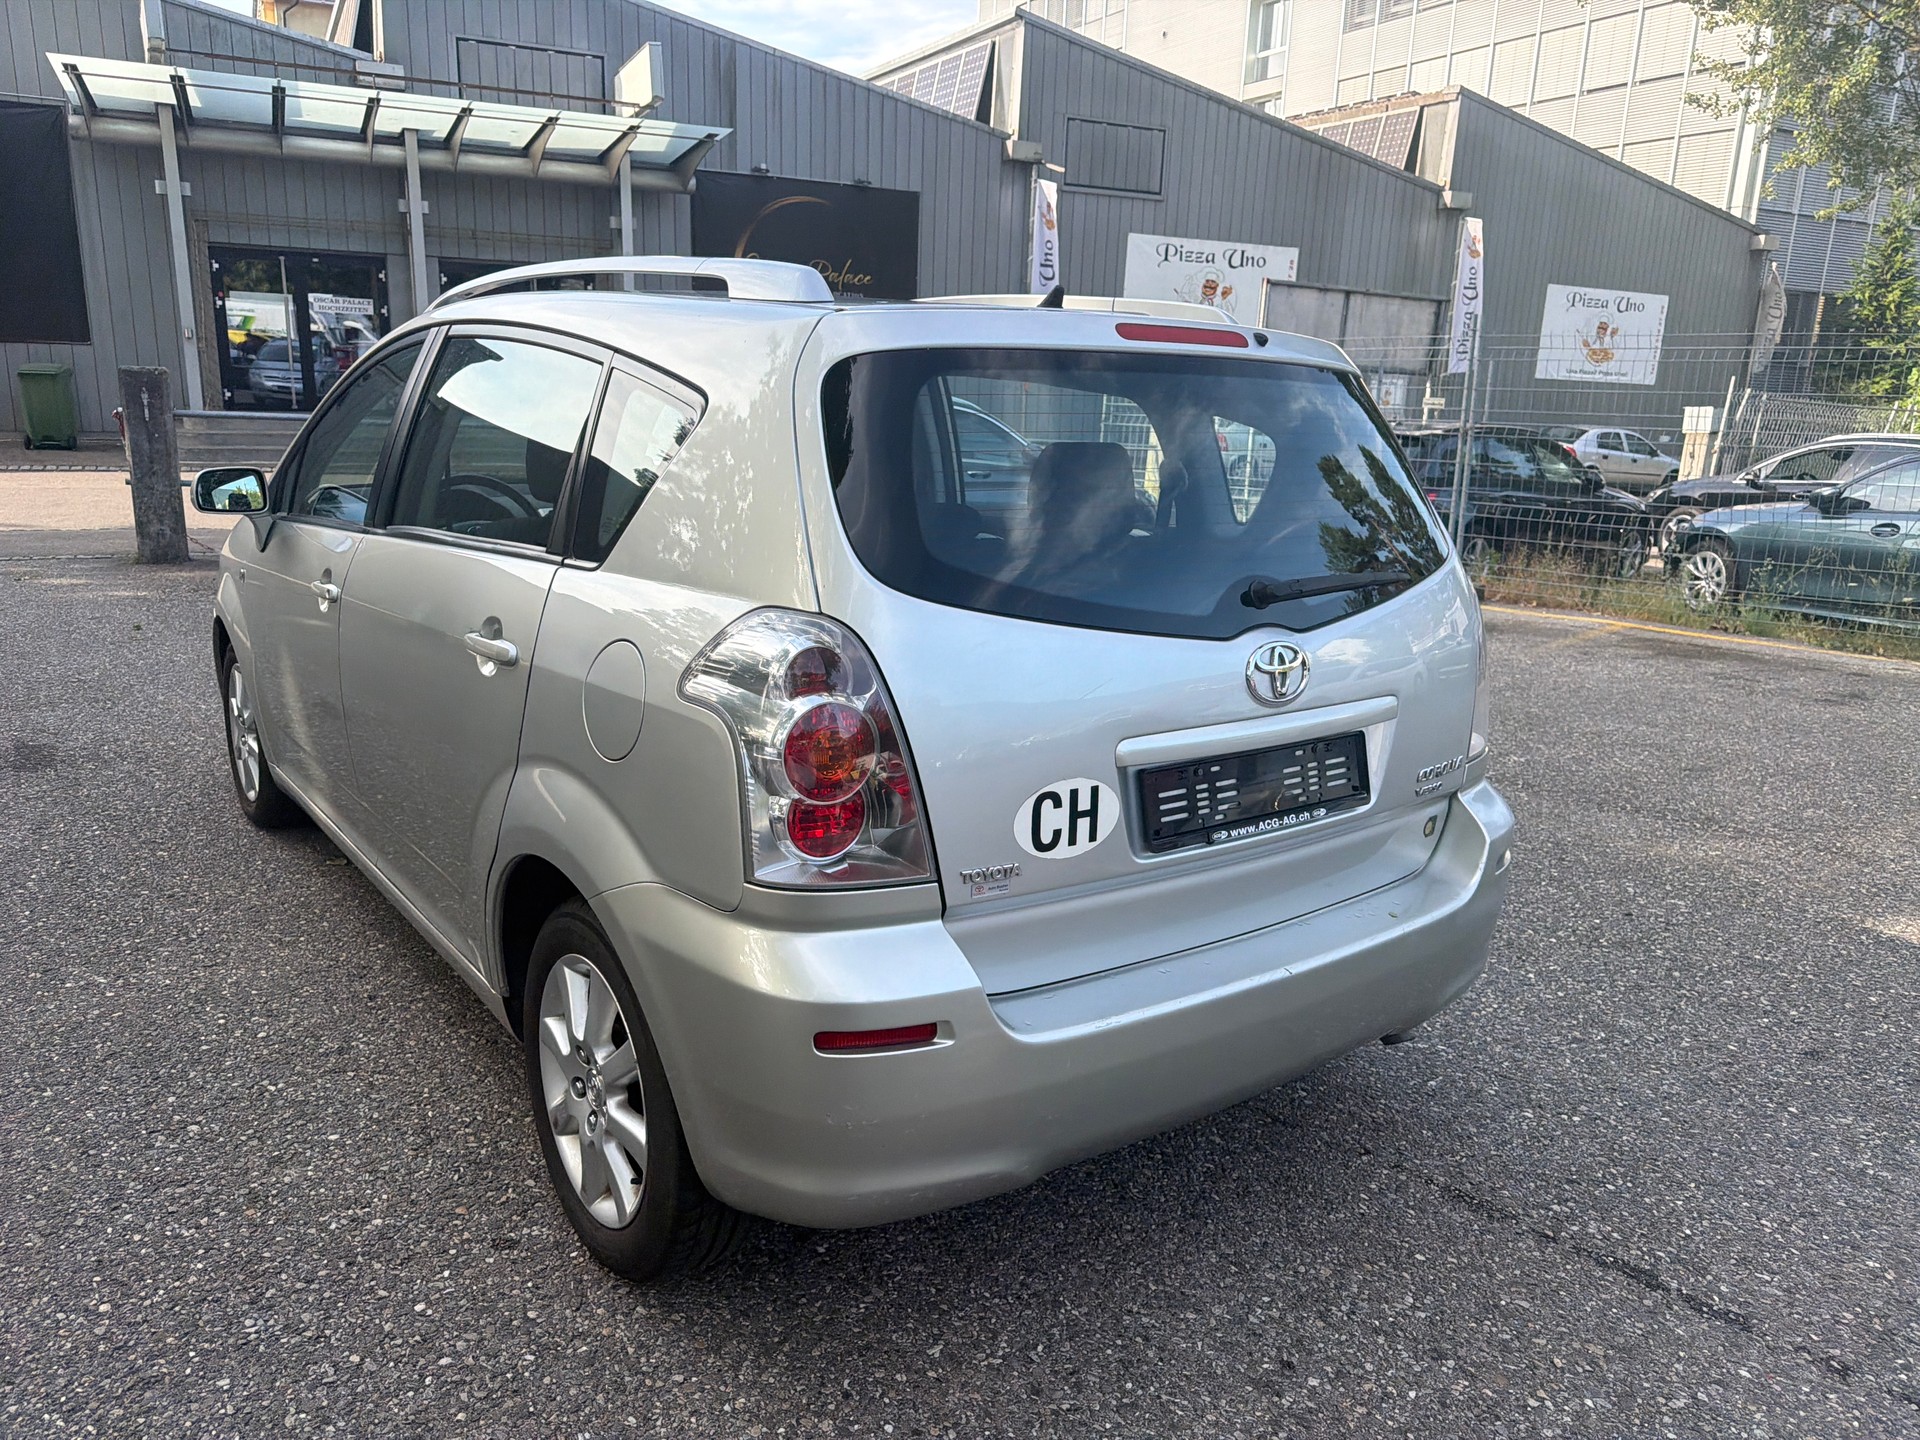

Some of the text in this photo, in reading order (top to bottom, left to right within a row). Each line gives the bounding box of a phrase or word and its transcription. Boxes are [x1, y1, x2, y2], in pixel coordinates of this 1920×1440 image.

[1039, 239, 1055, 287] Uno
[1156, 243, 1267, 269] Pizza Uno
[809, 258, 873, 290] Palace
[1462, 266, 1479, 306] Uno
[313, 297, 372, 306] OSCAR PALACE
[318, 304, 369, 313] HOCHZEITEN
[1566, 291, 1645, 313] Pizza Uno
[1766, 291, 1783, 323] Uno
[1031, 785, 1099, 853] CH
[1230, 811, 1310, 836] www.ACG-AG.ch
[960, 863, 1022, 884] TOYOTA
